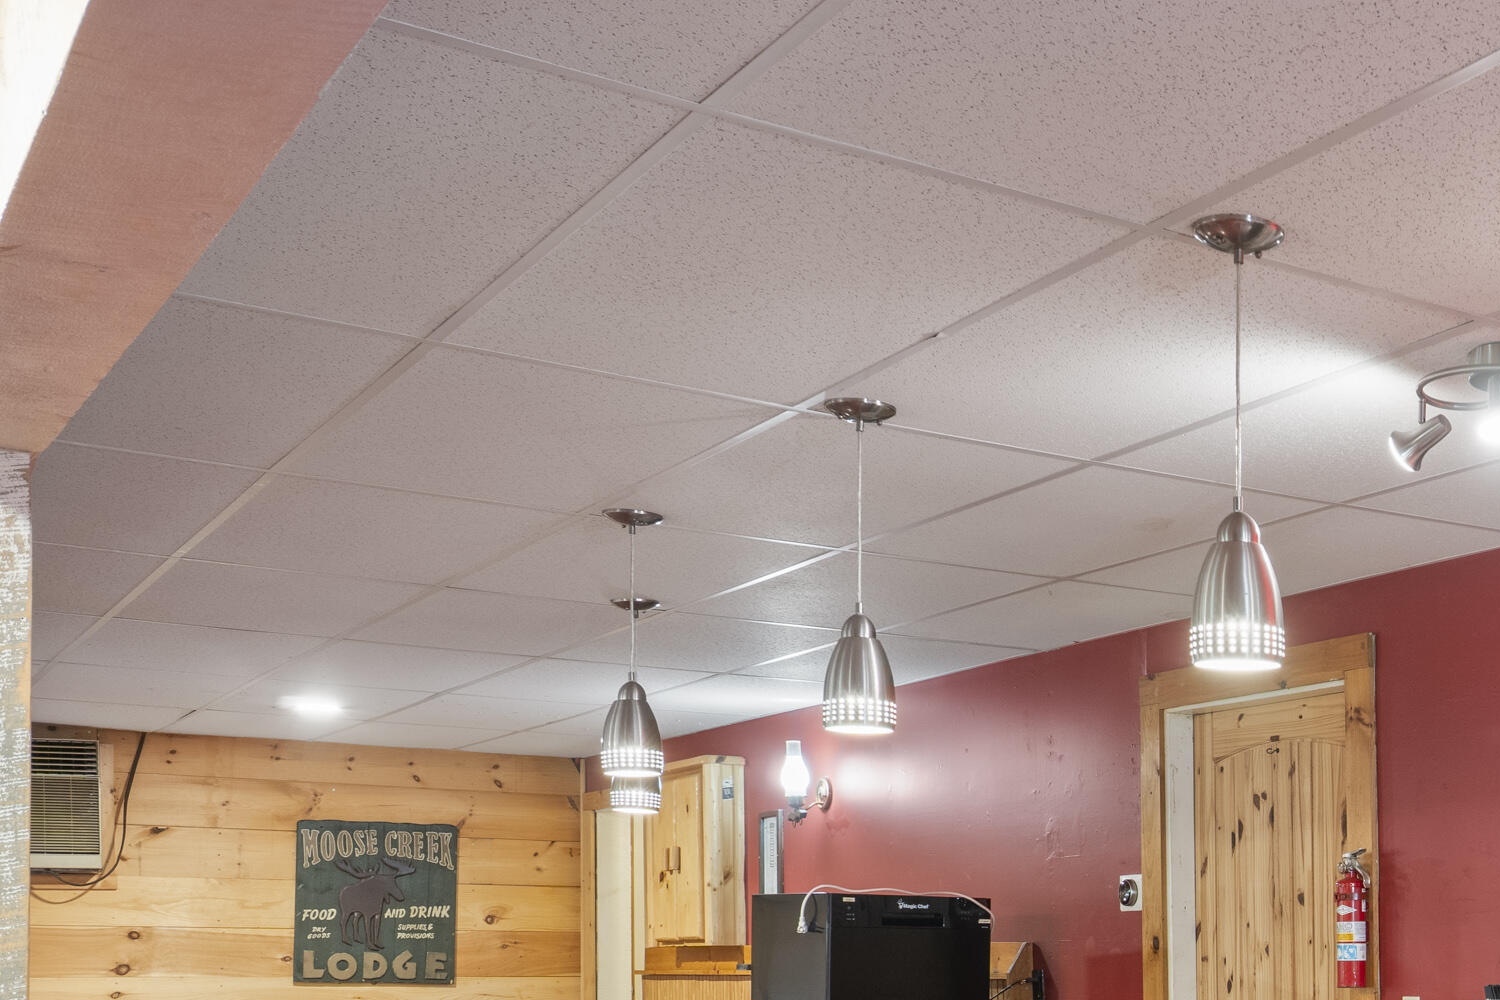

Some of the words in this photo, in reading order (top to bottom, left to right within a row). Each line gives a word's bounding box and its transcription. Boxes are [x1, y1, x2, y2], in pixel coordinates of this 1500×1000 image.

[301, 829, 378, 868] MOOSE
[384, 831, 454, 870] CREEK
[302, 908, 337, 921] FOOD
[384, 908, 406, 919] AND
[409, 905, 451, 919] DRINK
[307, 932, 332, 940] GOODS
[302, 950, 448, 980] LODGE
